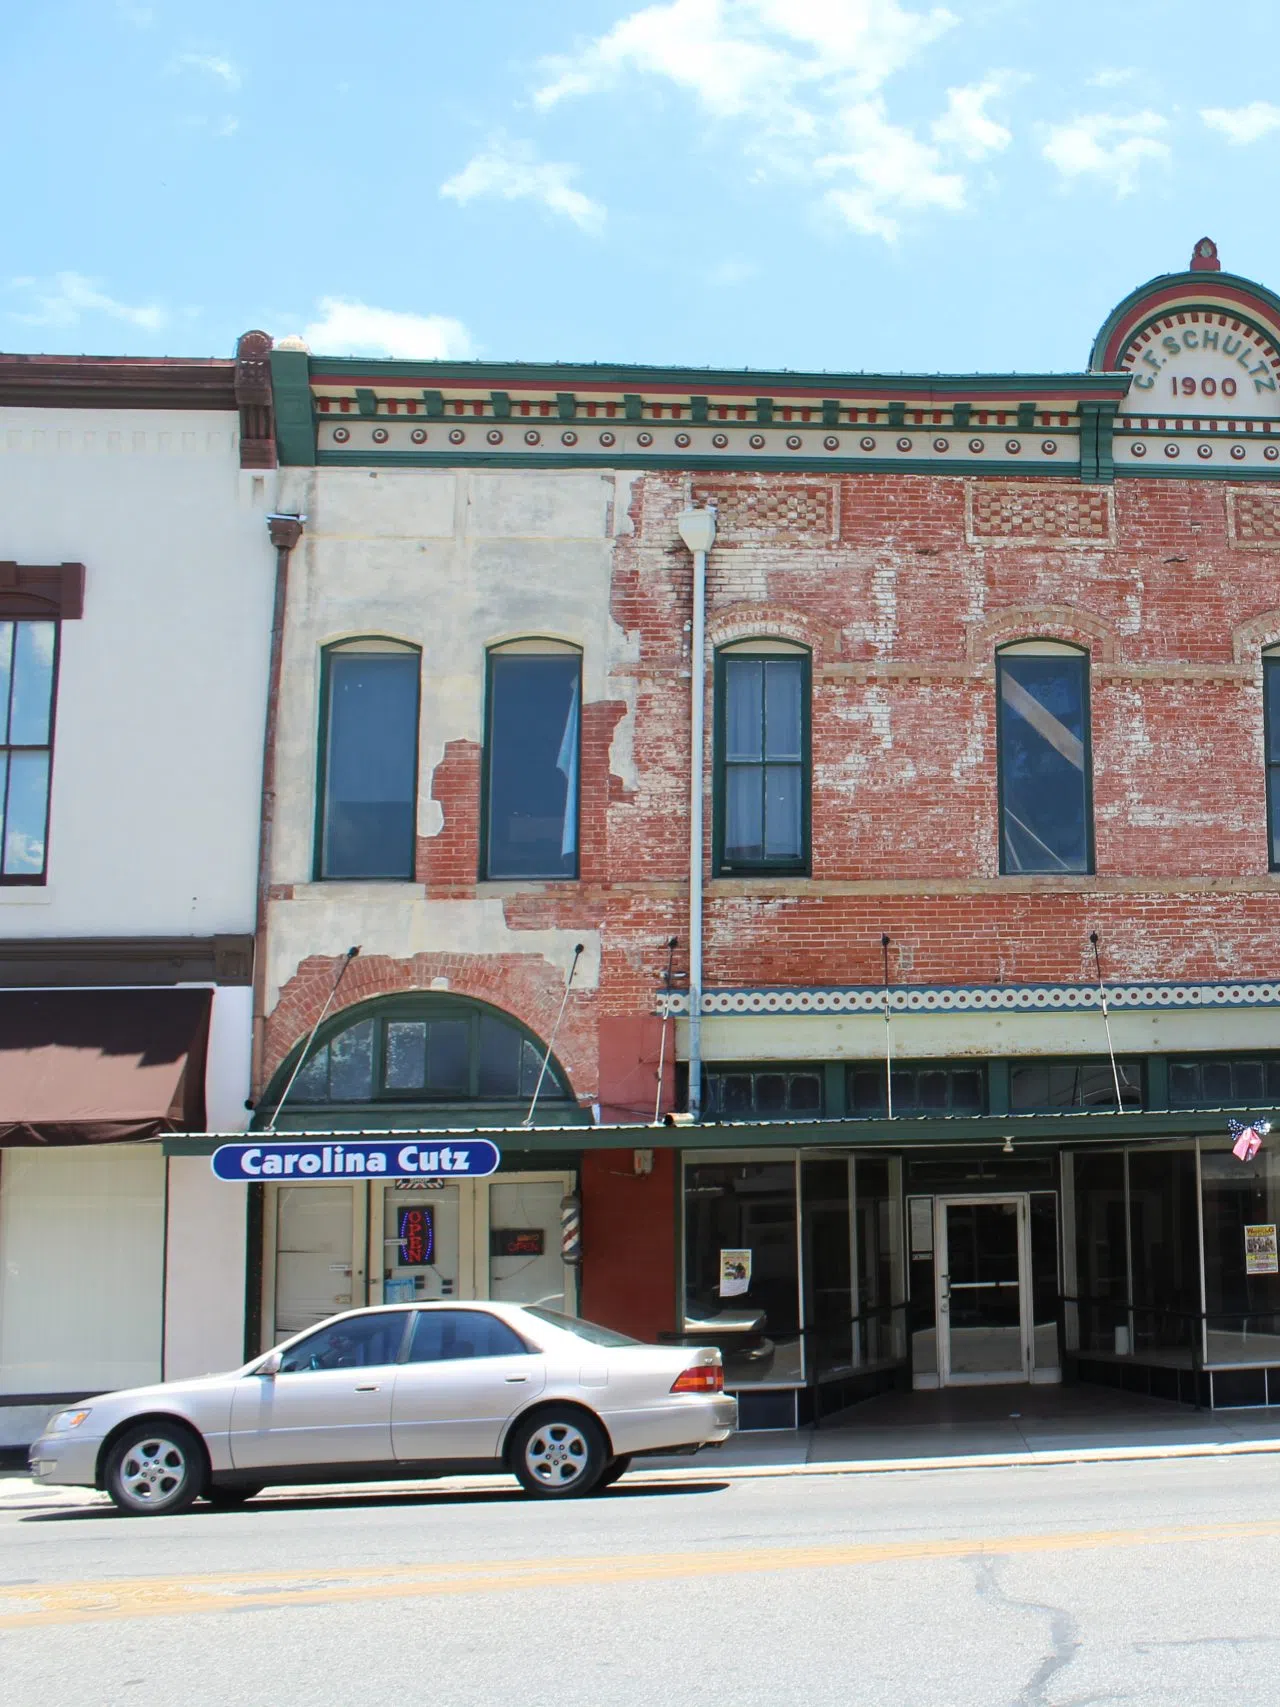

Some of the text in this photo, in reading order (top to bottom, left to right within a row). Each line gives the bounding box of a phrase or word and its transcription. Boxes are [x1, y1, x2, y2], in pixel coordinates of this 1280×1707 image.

[1133, 329, 1277, 394] C.F. SCHULTZ
[1171, 376, 1238, 398] 1900
[240, 1145, 471, 1176] Carolina Cutz
[408, 1210, 422, 1263] OPEN
